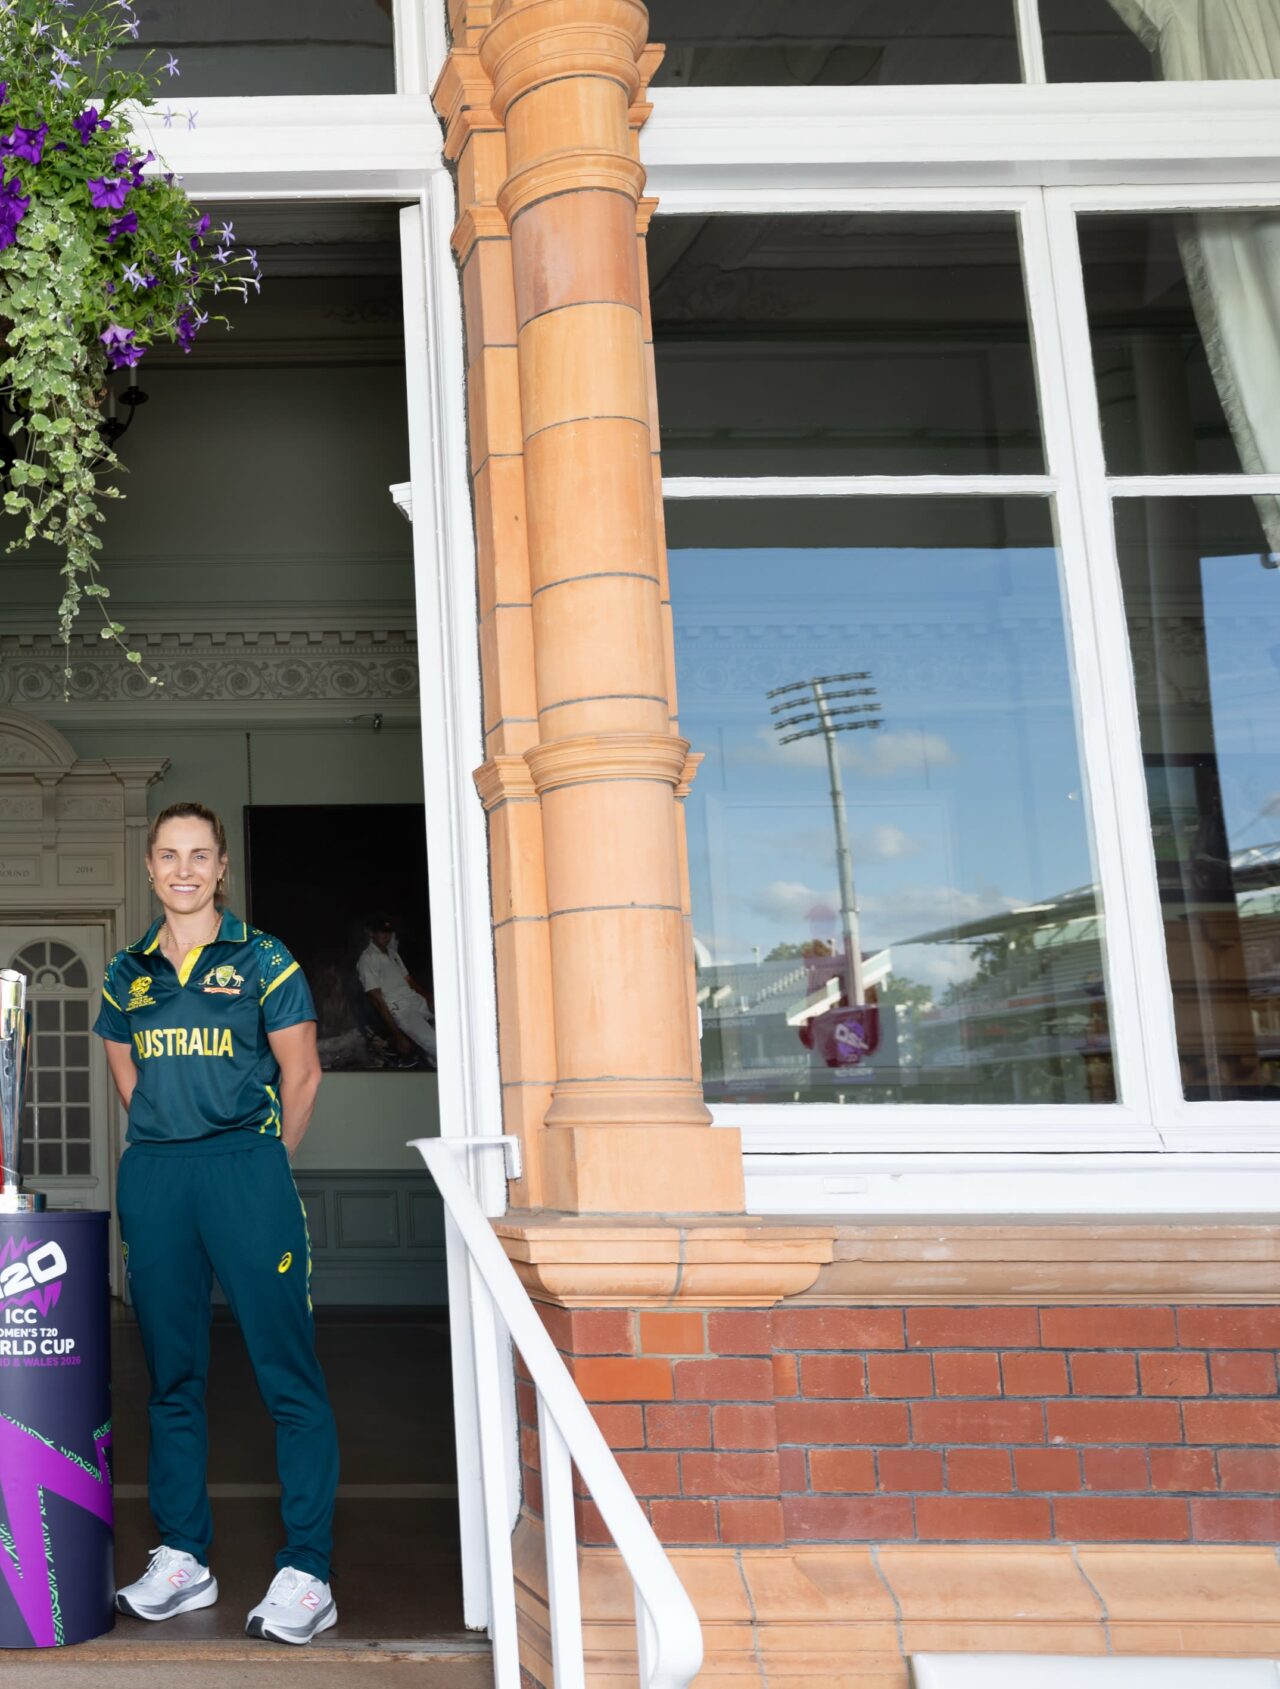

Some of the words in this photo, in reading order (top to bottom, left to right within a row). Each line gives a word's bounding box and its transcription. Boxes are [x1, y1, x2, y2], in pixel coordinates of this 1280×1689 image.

[134, 1027, 234, 1059] AUSTRALIA
[5, 1308, 37, 1324] ICC
[40, 1328, 59, 1337] T20
[40, 1339, 75, 1354] CUP
[13, 1357, 20, 1367] &
[23, 1356, 59, 1366] WALES
